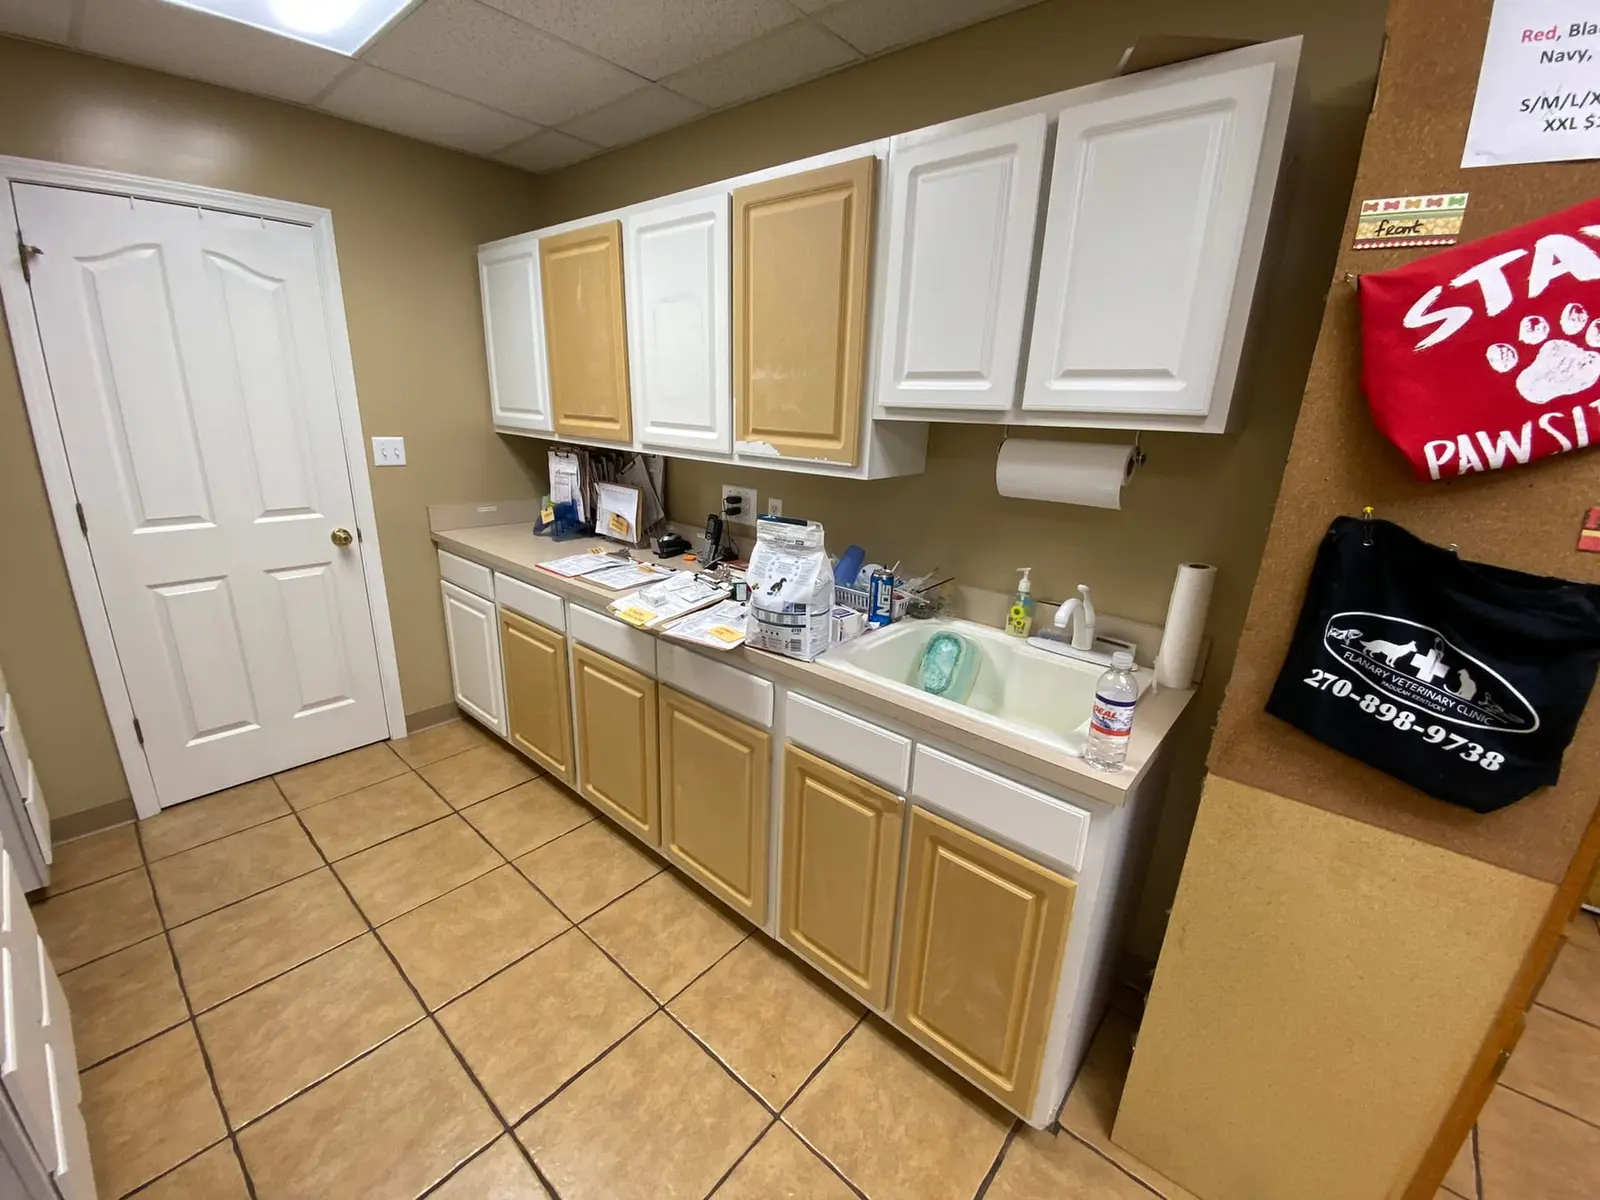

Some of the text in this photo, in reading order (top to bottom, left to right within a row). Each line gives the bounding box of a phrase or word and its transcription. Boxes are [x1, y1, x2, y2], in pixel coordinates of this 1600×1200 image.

[1521, 22, 1600, 44] Red, Bla
[1540, 49, 1593, 65] Navy,
[1543, 117, 1577, 132] XXL
[876, 580, 892, 616] NOS
[1343, 651, 1495, 725] FLANARY VETERINARY CLINIC
[1410, 692, 1446, 713] KENTUCKY
[1302, 668, 1505, 772] 270-898-9738
